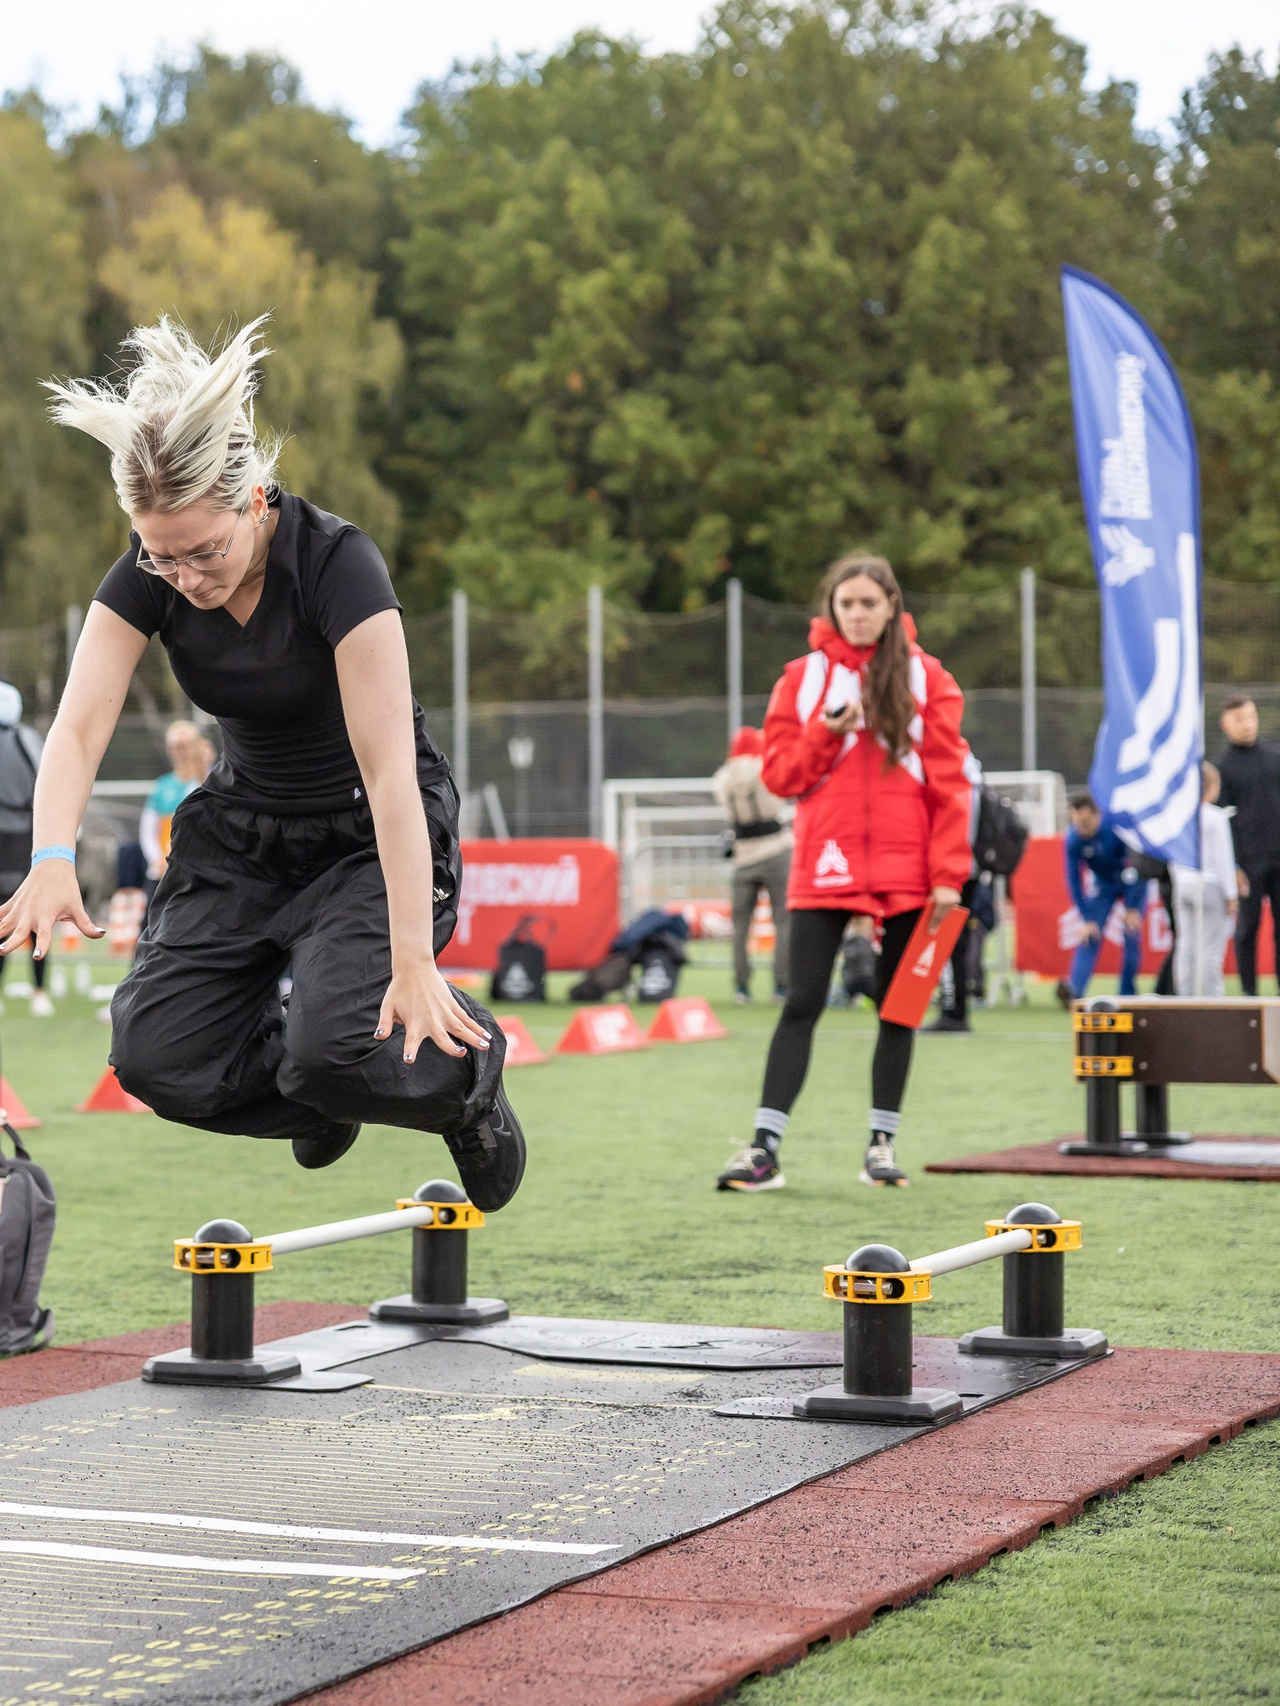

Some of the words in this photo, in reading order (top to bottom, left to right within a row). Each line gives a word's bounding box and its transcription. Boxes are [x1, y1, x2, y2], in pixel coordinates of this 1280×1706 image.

[327, 1576, 418, 1589] 190
[285, 1589, 394, 1603] 200
[253, 1601, 362, 1614] 210
[219, 1612, 327, 1627] 220
[183, 1626, 293, 1641] 230
[24, 1681, 145, 1699] 270
